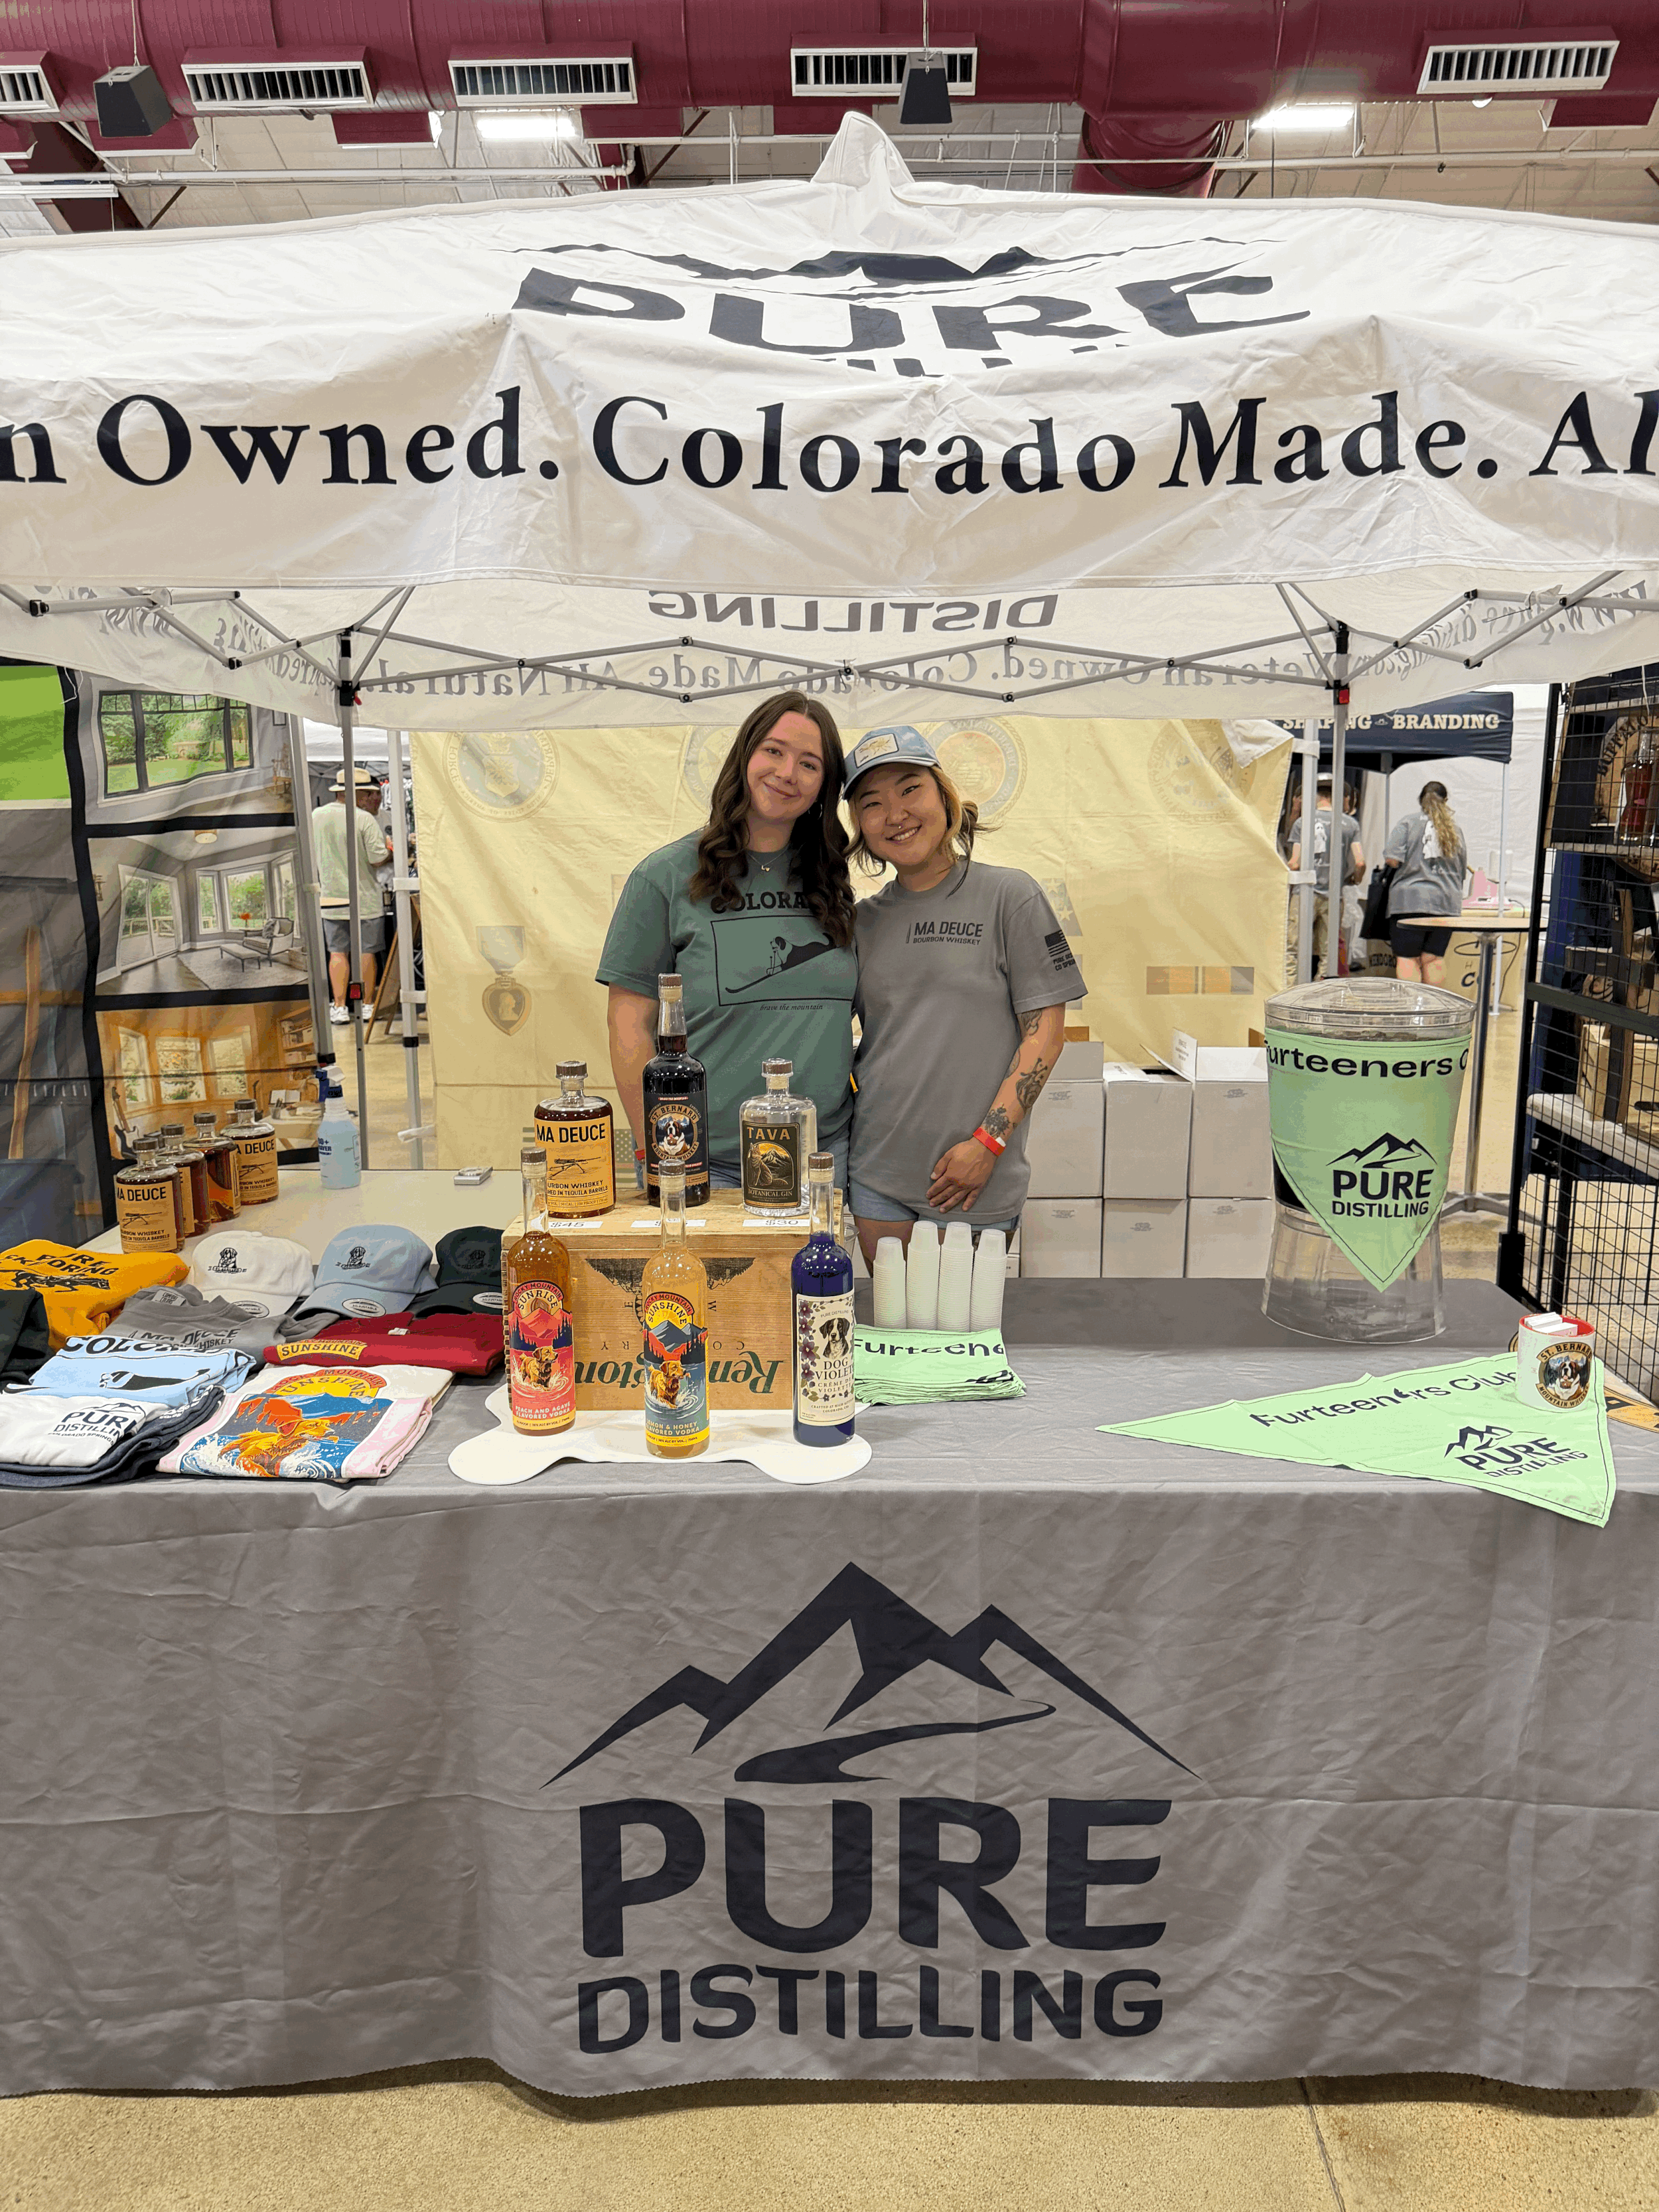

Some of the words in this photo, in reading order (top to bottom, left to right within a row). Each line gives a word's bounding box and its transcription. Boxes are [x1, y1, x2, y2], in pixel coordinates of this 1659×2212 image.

[97, 386, 559, 486] Owned.
[593, 396, 1136, 494] Colorado
[1159, 390, 1497, 489] Made.
[1283, 715, 1372, 730] SHPNG
[1392, 714, 1499, 729] BRANDING
[914, 922, 934, 936] MA
[939, 921, 983, 938] DEUCE
[946, 936, 981, 945] WHISKEY
[660, 1105, 697, 1121] BERNARD
[536, 1124, 555, 1143] MA
[559, 1123, 606, 1143] DEUCE
[747, 1127, 790, 1141] TAVA
[245, 1139, 275, 1154] DEUCE
[571, 1179, 603, 1189] WHISKEY
[588, 1185, 608, 1194] BARRELS
[1333, 1169, 1435, 1200] PURE
[127, 1186, 167, 1201] DEUCE
[748, 1189, 780, 1197] BOTANICAL
[1332, 1200, 1429, 1218] DISTILLING
[514, 1285, 528, 1301] ROCKY
[530, 1282, 562, 1298] MOUNTAIN
[518, 1290, 558, 1309] SUNRISE
[645, 1295, 658, 1310] ROCKY
[659, 1293, 692, 1313] MOUNTAIN
[648, 1302, 687, 1324] SUNSHINE
[195, 1338, 234, 1350] HISKEY
[281, 1343, 360, 1357] SUNSHINE
[1540, 1349, 1554, 1361] ST.
[1556, 1343, 1593, 1359] BERNARD
[824, 1357, 848, 1370] DOG
[324, 1369, 384, 1386] MOUNTAIN
[816, 1364, 853, 1380] VIOLET
[280, 1377, 366, 1398] UNSHINE
[1539, 1386, 1568, 1407] MOUNTAIN
[516, 1411, 547, 1420] FLAVORED
[549, 1407, 570, 1418] VODKA
[552, 1401, 570, 1412] AGAVE
[53, 1424, 125, 1439] DISTILLIN
[673, 1421, 697, 1430] HONEY
[675, 1426, 699, 1436] VODKA
[1455, 1436, 1571, 1471] PURE
[1485, 1451, 1589, 1479] DISTILLING
[579, 1797, 1173, 1958] PURE
[577, 1963, 1163, 2054] DISTILLING
